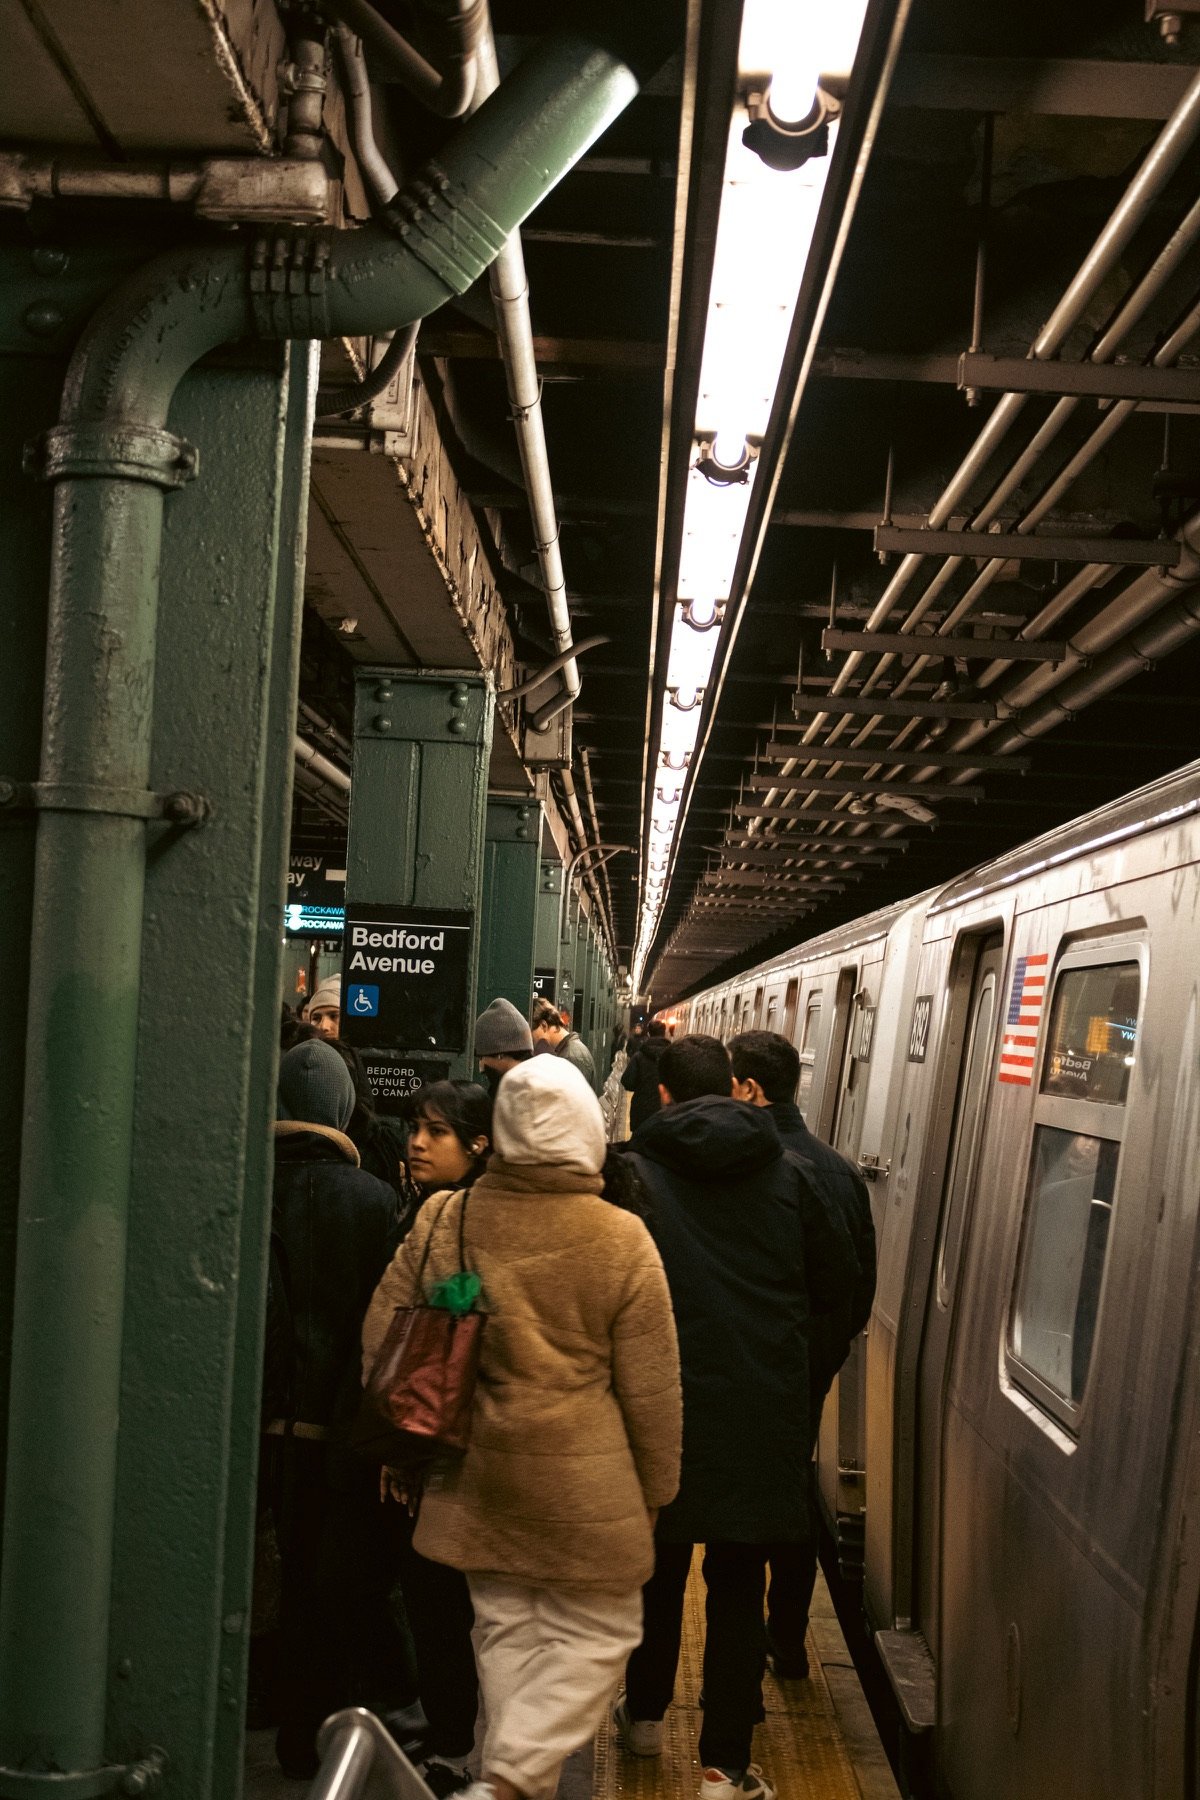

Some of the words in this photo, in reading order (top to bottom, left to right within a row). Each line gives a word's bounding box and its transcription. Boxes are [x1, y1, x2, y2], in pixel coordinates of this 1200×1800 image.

[302, 905, 345, 915] ROCKAWA
[301, 919, 345, 930] ROCKAWA
[352, 927, 444, 951] Bedford
[349, 951, 435, 974] Avenue
[366, 1066, 415, 1077] BEDFORD
[371, 1087, 379, 1096] O
